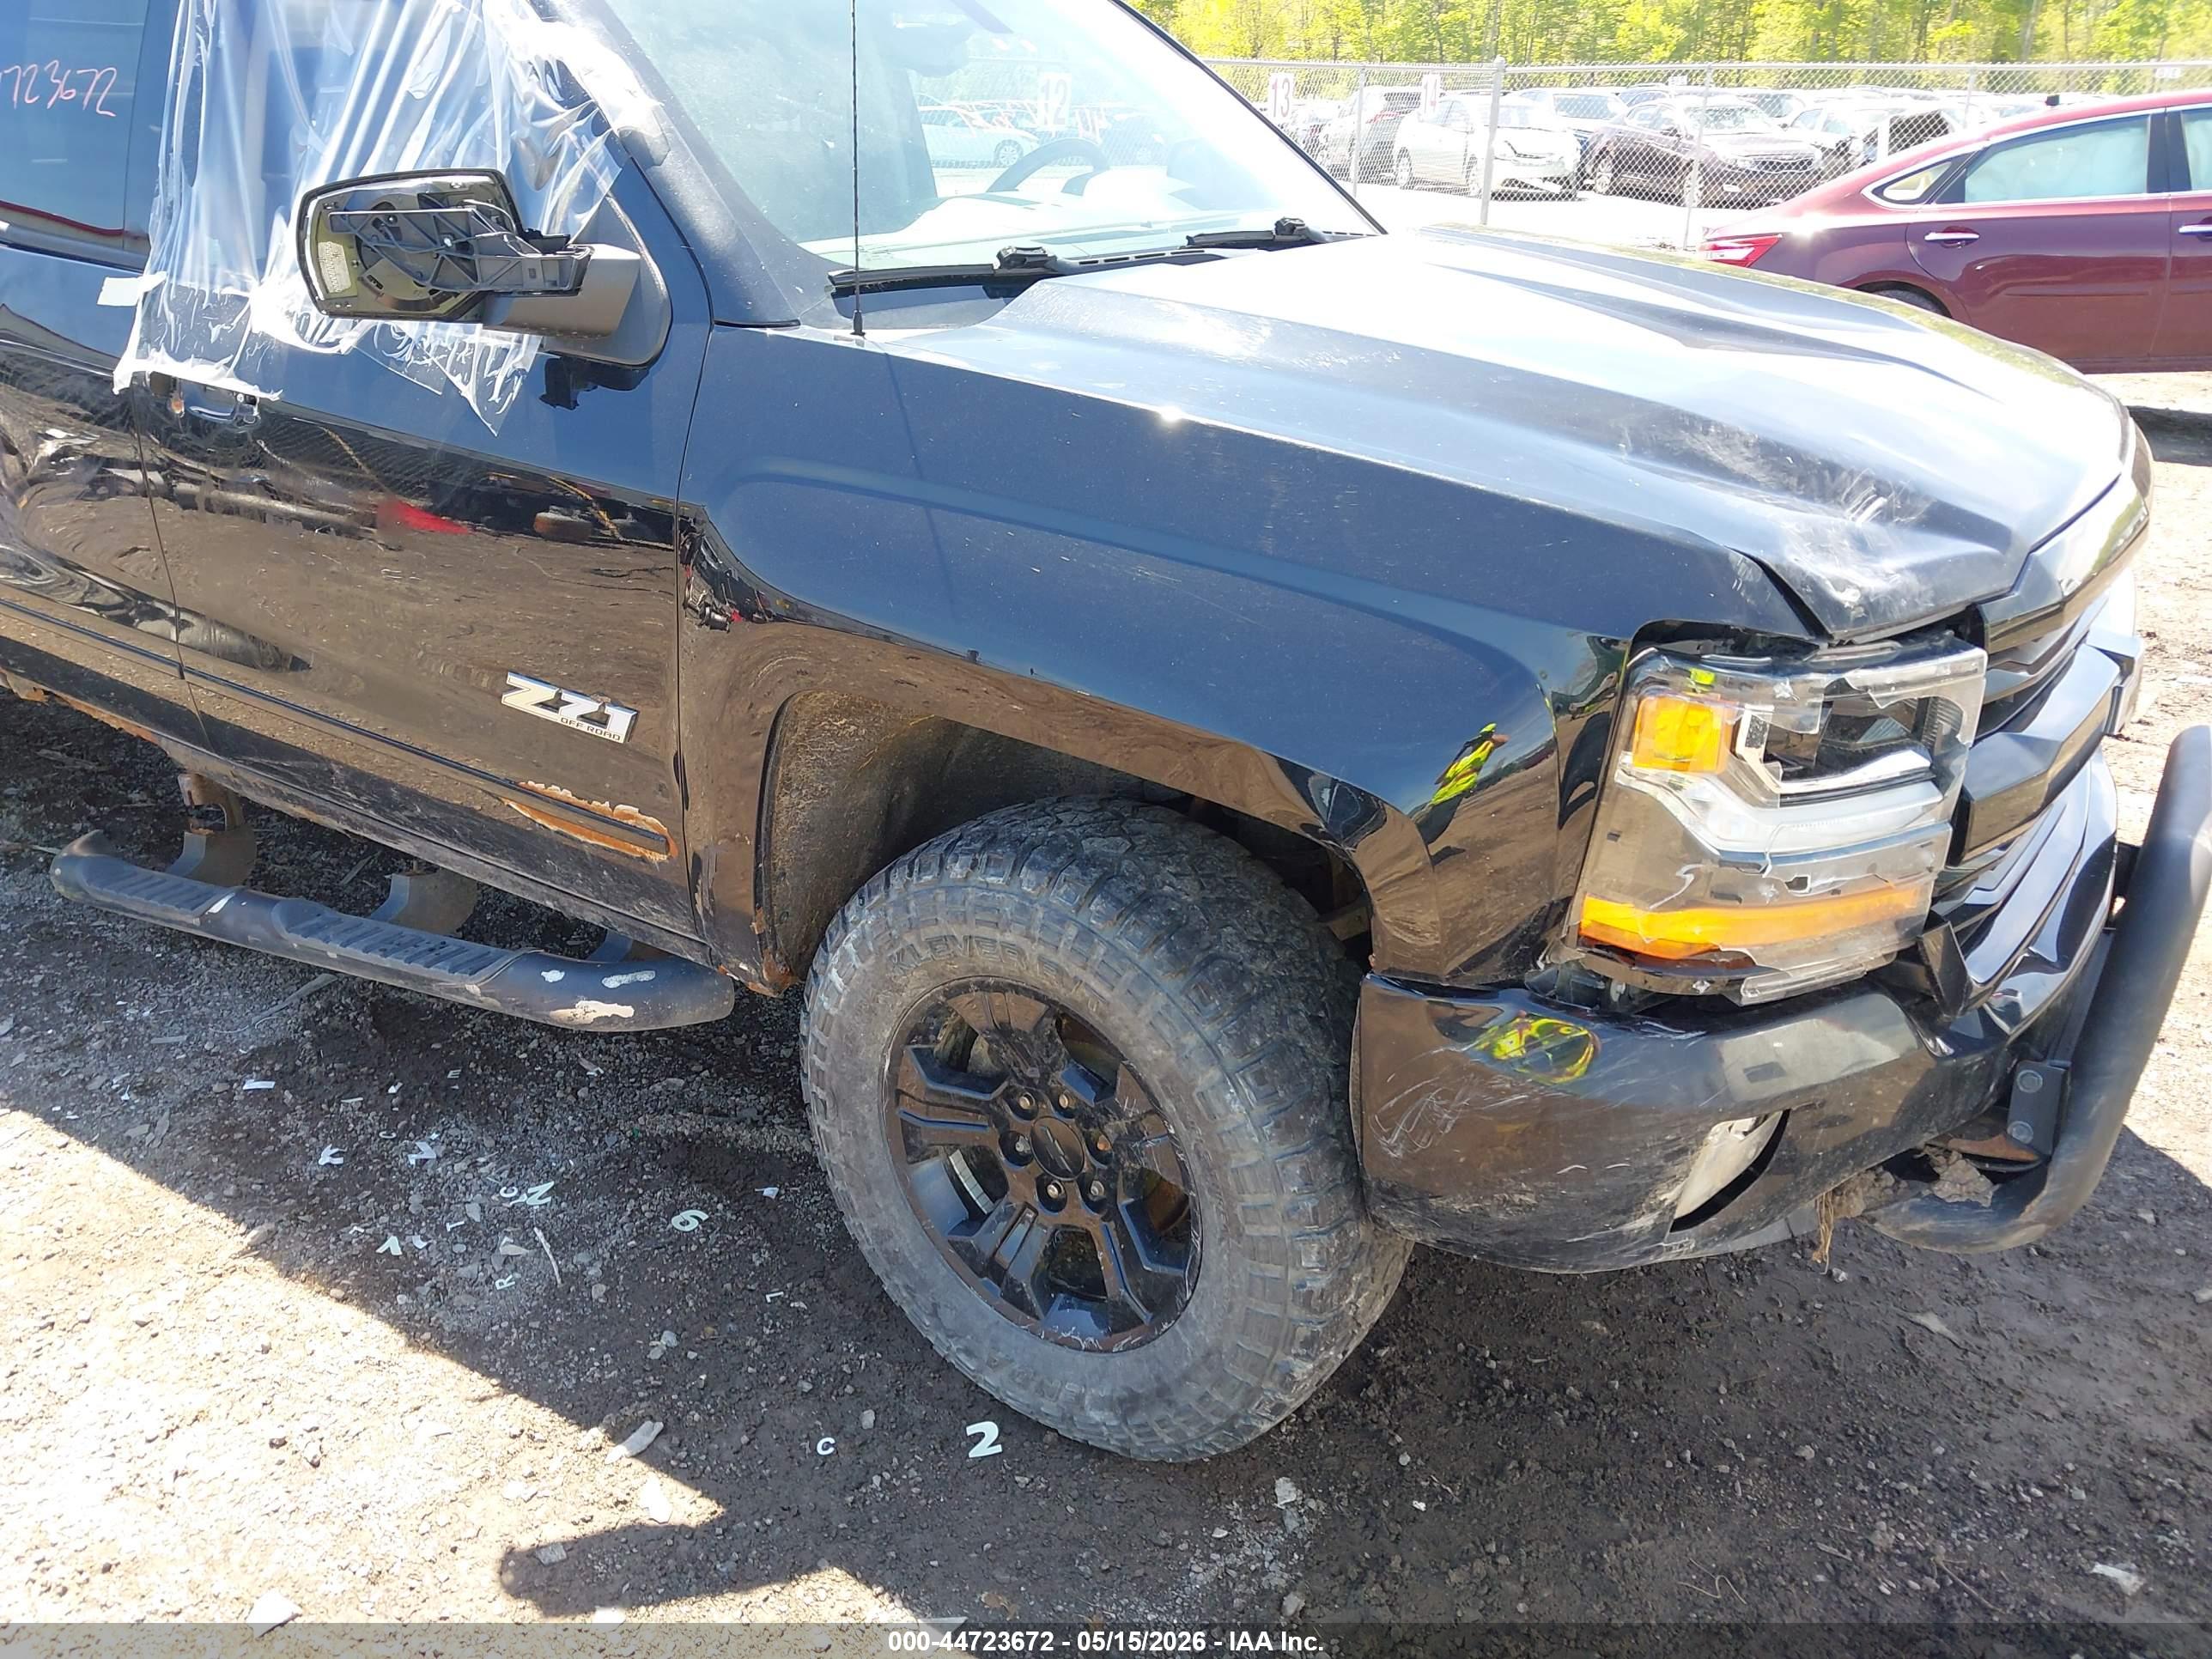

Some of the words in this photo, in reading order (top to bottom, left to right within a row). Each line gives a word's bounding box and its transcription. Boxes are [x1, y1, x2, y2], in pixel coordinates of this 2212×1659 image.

[0, 60, 117, 117] 723672
[1040, 79, 1068, 125] 12
[1272, 77, 1291, 118] 13
[501, 671, 637, 743] Z71
[560, 716, 584, 728] OFF
[586, 725, 622, 741] ROAD
[888, 934, 1028, 978] KLEVER
[447, 1069, 461, 1079] E
[495, 1274, 515, 1291] R
[965, 1421, 1003, 1458] 2
